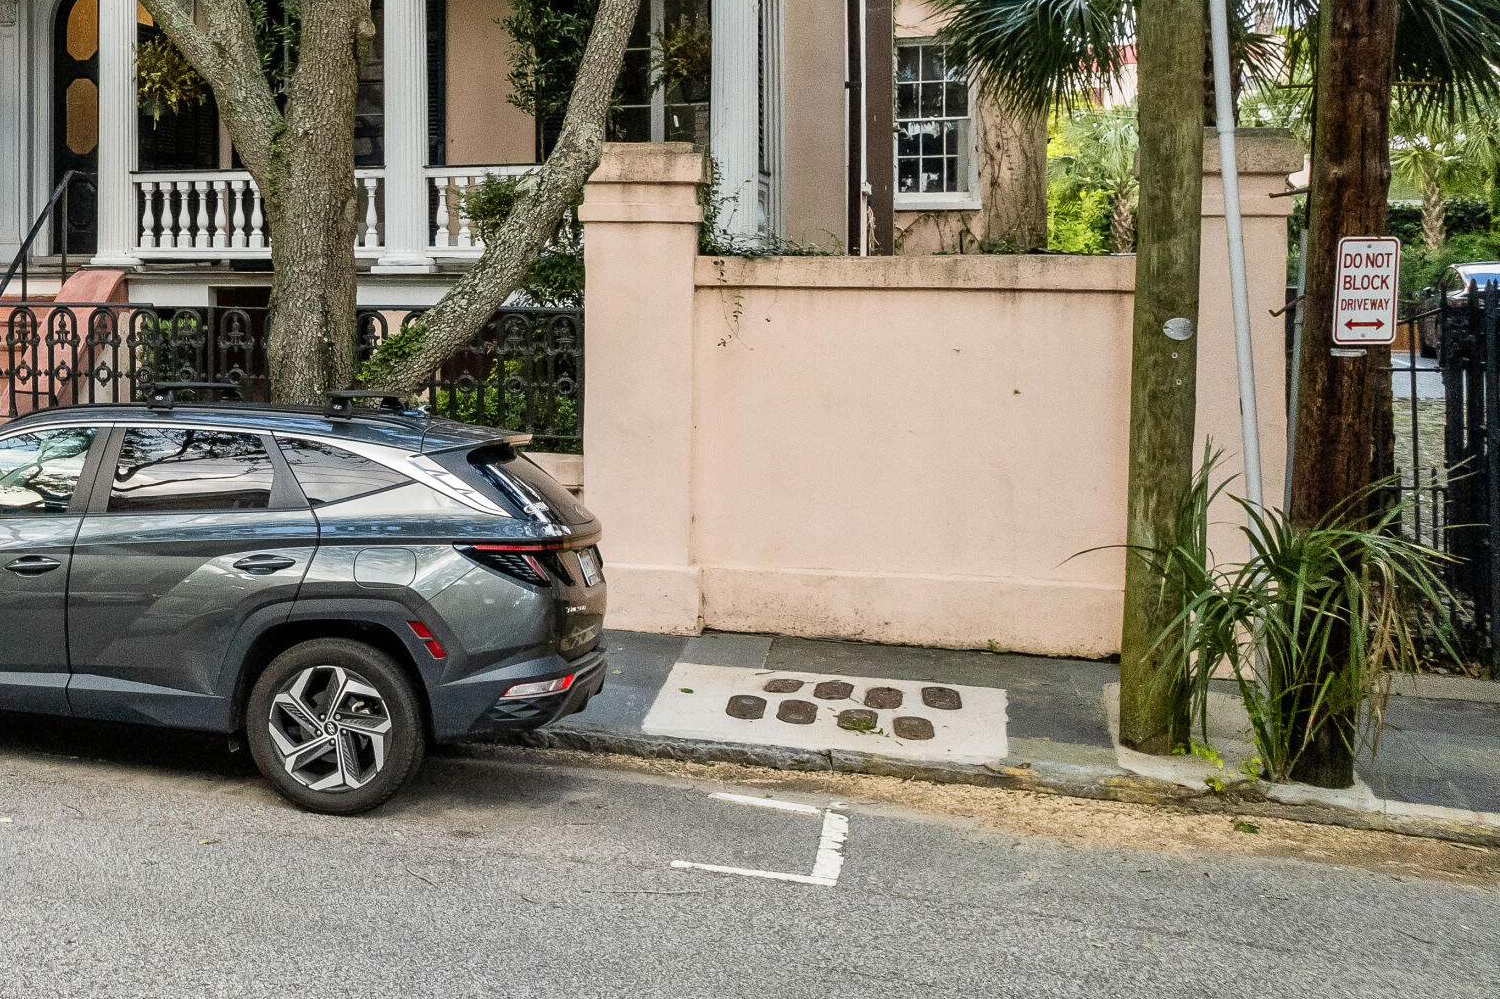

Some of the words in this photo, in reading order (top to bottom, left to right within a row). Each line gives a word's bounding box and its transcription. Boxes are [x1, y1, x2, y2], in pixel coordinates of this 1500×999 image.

[1343, 253, 1362, 268] DO
[1365, 253, 1393, 268] NOT
[1343, 274, 1390, 290] BLOCK
[1340, 298, 1390, 311] DRIVEWAY
